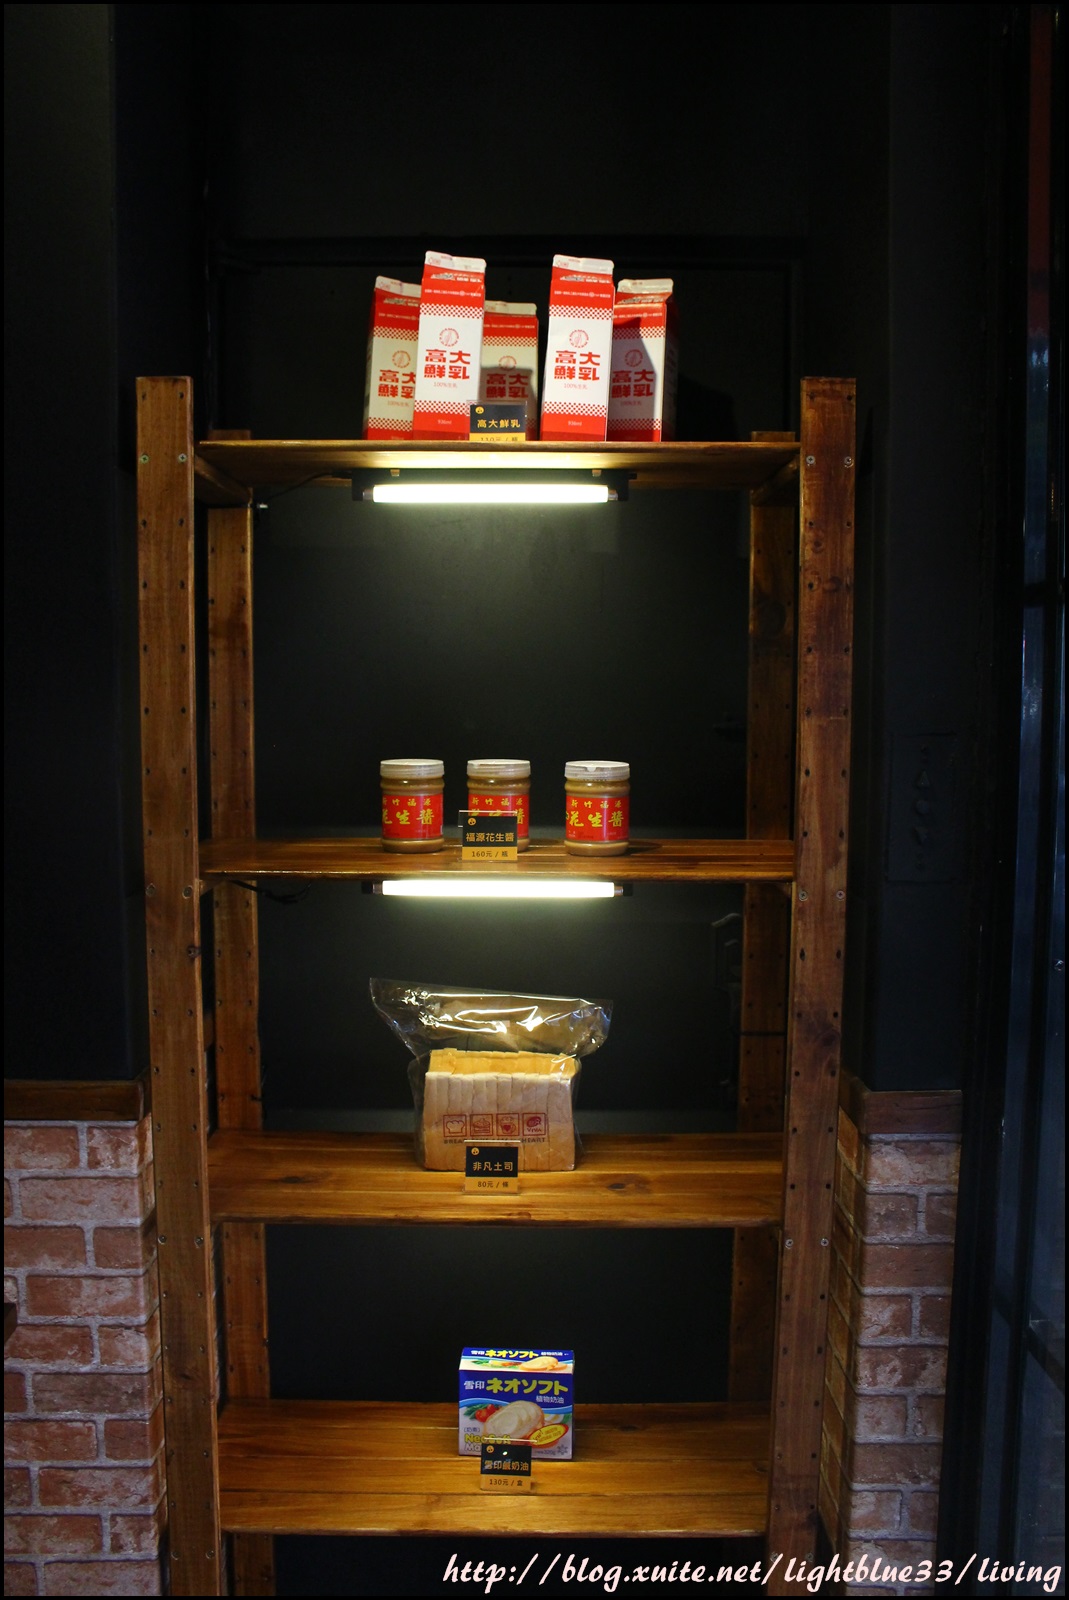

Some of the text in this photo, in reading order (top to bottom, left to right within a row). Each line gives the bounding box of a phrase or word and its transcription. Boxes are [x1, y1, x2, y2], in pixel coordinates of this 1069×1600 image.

[425, 349, 471, 365] 高大
[555, 350, 601, 366] 高大
[423, 364, 471, 380] 鮮乳
[553, 366, 600, 381] 鮮乳
[612, 369, 654, 383] 高大
[486, 373, 529, 385] 高大
[486, 386, 529, 399] 鮮乳
[611, 384, 653, 399] 鮮乳
[477, 419, 521, 429] 高大鮮乳
[466, 833, 514, 842] 福源花生醬
[471, 850, 493, 858] 160元
[473, 1162, 513, 1172] 非凡土司
[485, 1350, 538, 1358] ネオソフト
[464, 1378, 568, 1395] 雪印 ネオソフト
[536, 1395, 564, 1404] 植物奶油
